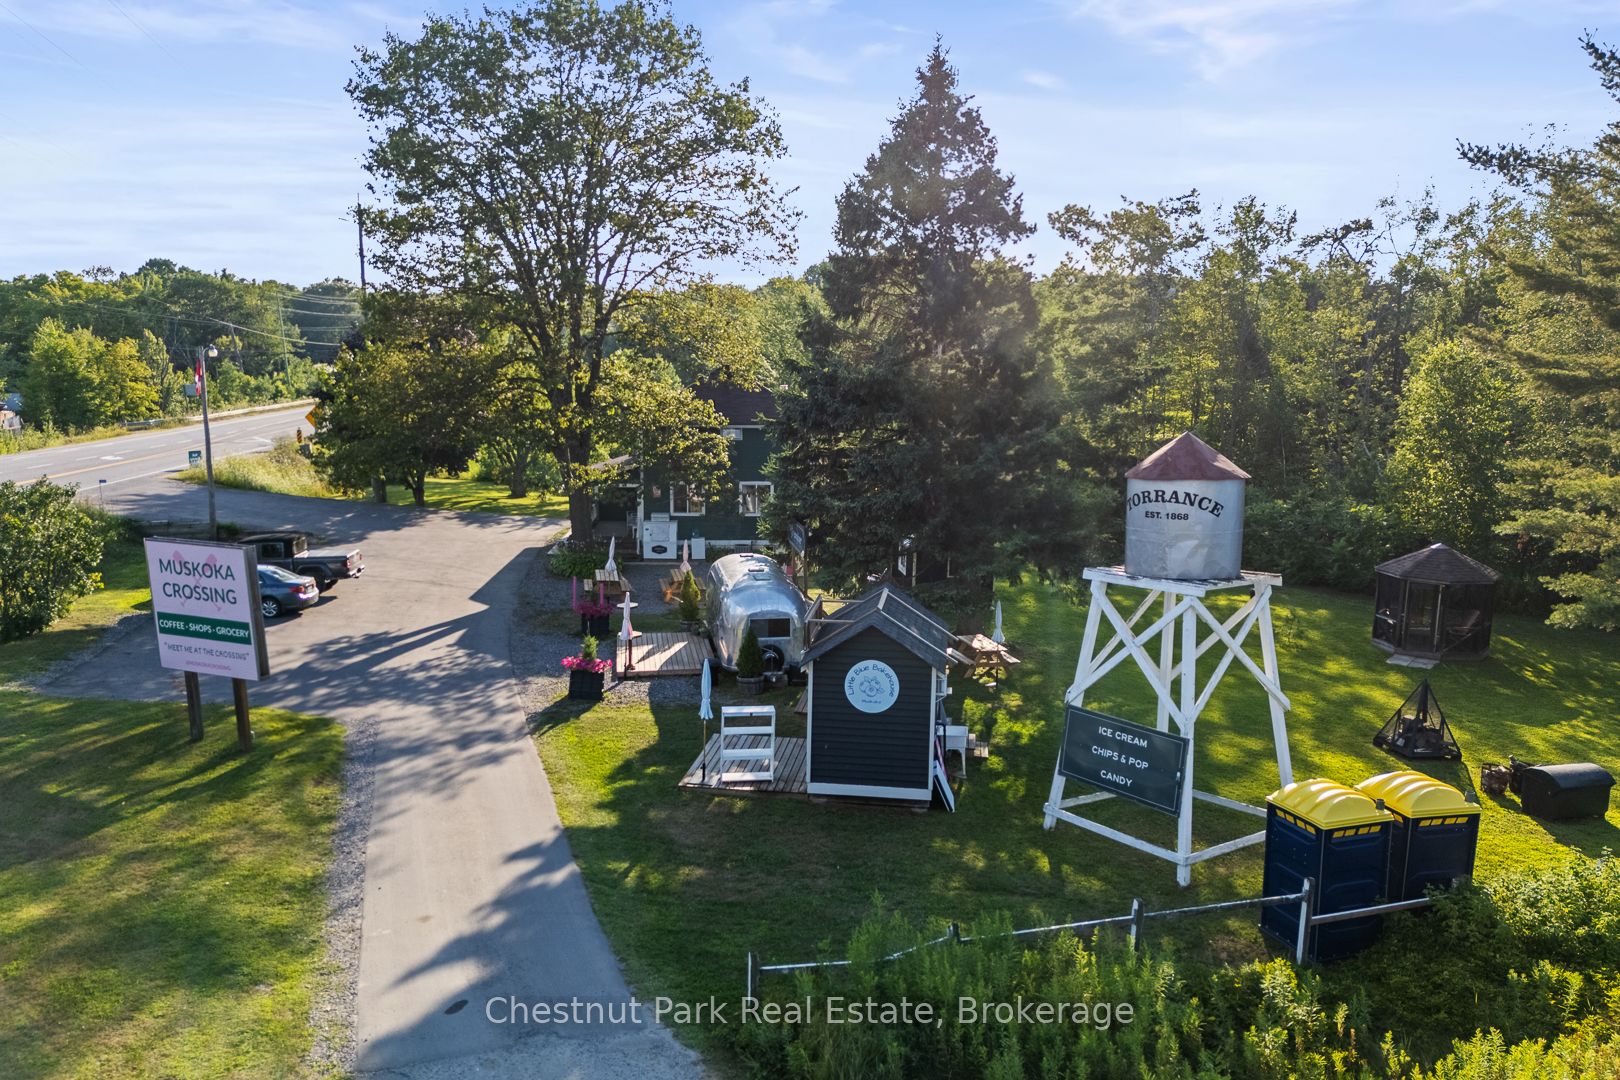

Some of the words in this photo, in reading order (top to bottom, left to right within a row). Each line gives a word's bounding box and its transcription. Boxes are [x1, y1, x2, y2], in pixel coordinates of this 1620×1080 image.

[1127, 489, 1224, 518] TORRANCE
[1145, 511, 1162, 519] EST.
[1166, 512, 1189, 521] 1868
[159, 558, 235, 581] MUSKOKA
[162, 582, 237, 605] CROSSING
[159, 619, 185, 630] COFFEE
[189, 622, 212, 634] SHOPS
[216, 626, 249, 637] GROCERY
[194, 647, 202, 655] AT
[203, 648, 214, 656] THE
[1098, 726, 1113, 738] ICE
[1115, 731, 1148, 748] CREAM
[1091, 745, 1119, 761] CHIPS
[1120, 755, 1126, 763] &
[1128, 757, 1149, 770] POP
[1100, 770, 1133, 787] CANDY
